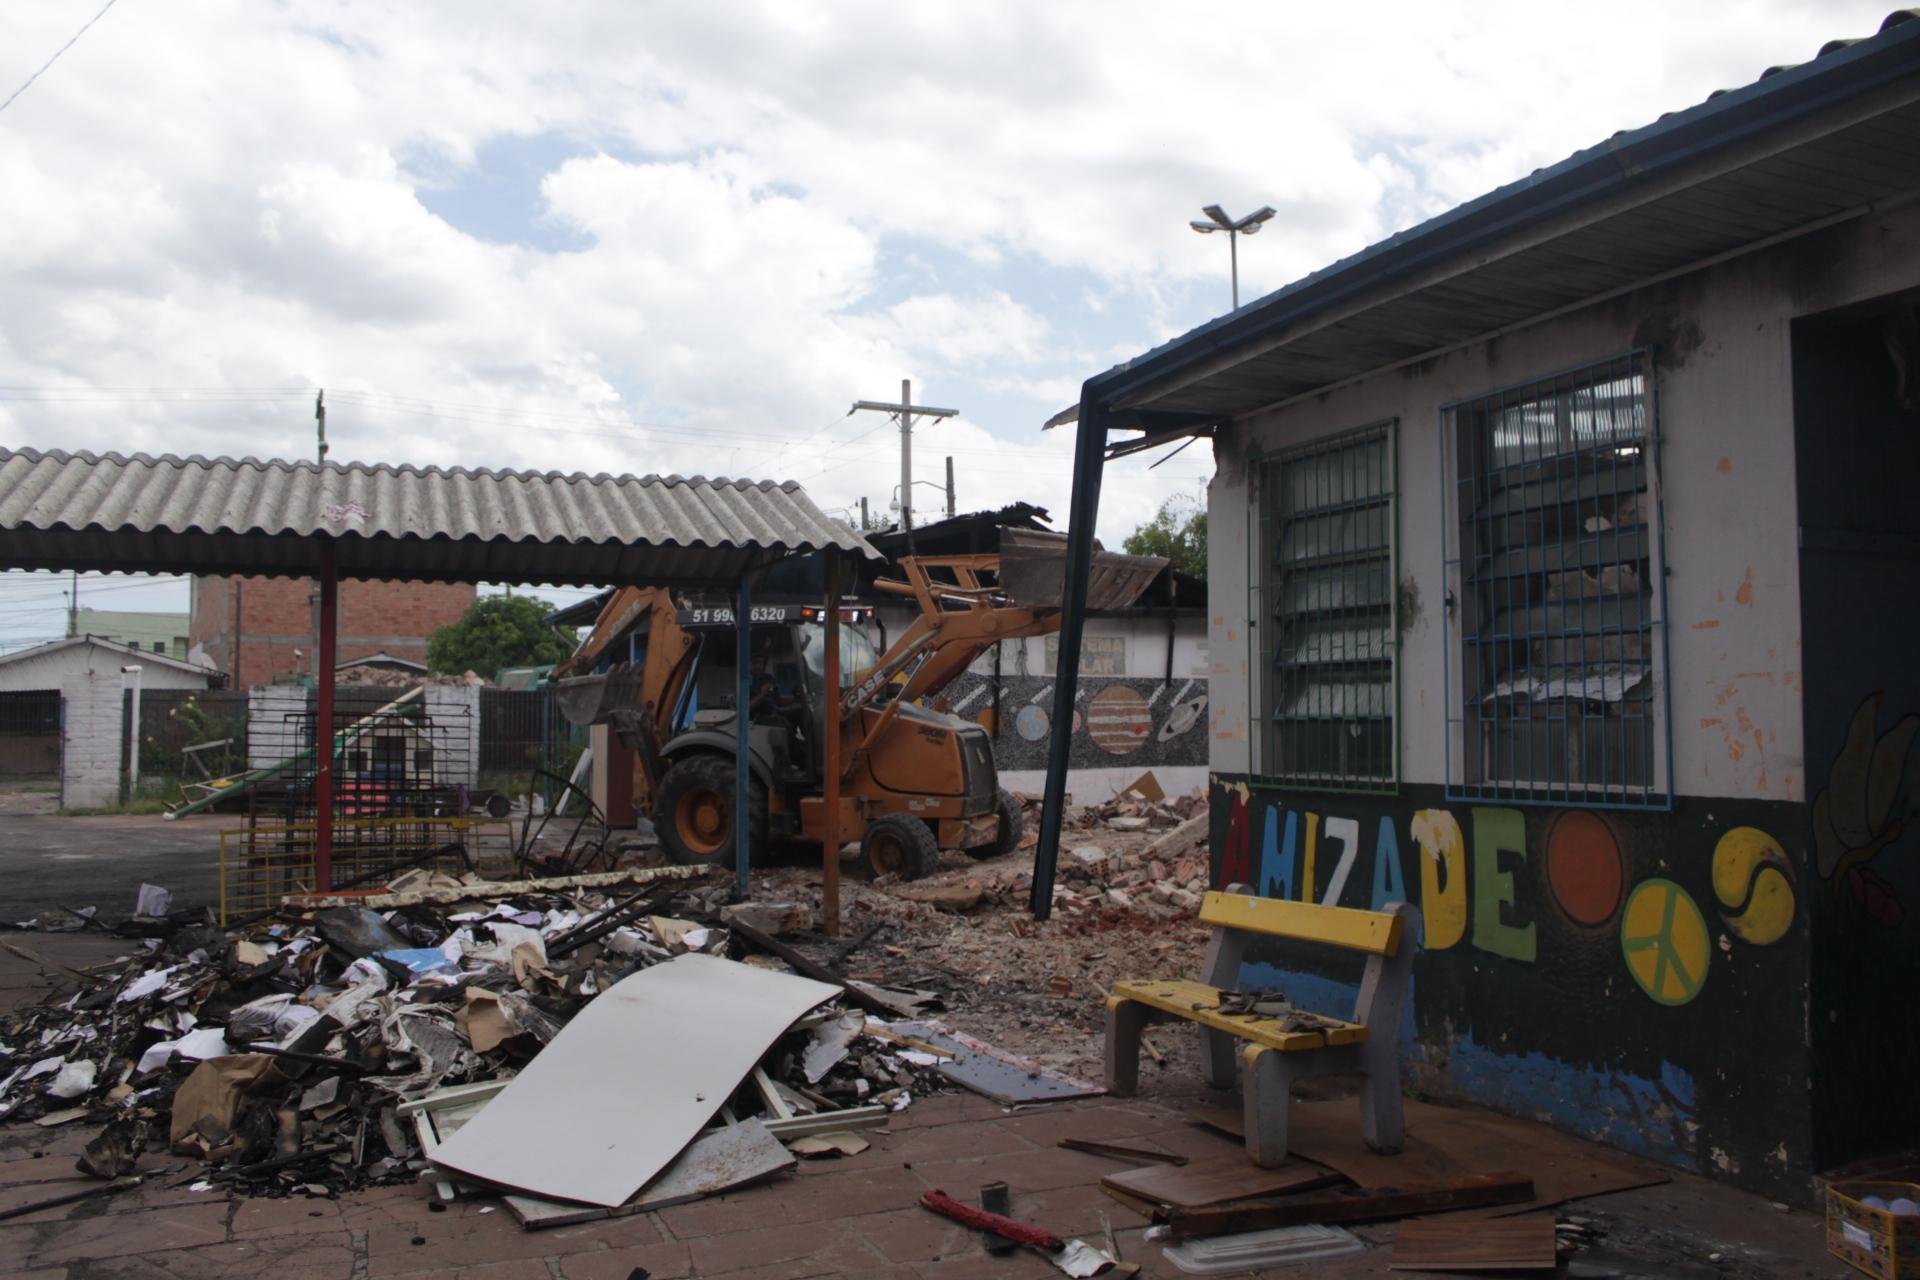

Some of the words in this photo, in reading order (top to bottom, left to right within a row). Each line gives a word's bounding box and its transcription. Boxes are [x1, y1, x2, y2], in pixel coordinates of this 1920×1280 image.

[692, 608, 709, 623] 51
[750, 606, 786, 621] 6320
[847, 671, 887, 709] CASE
[1215, 782, 1537, 963] AMIZADE
